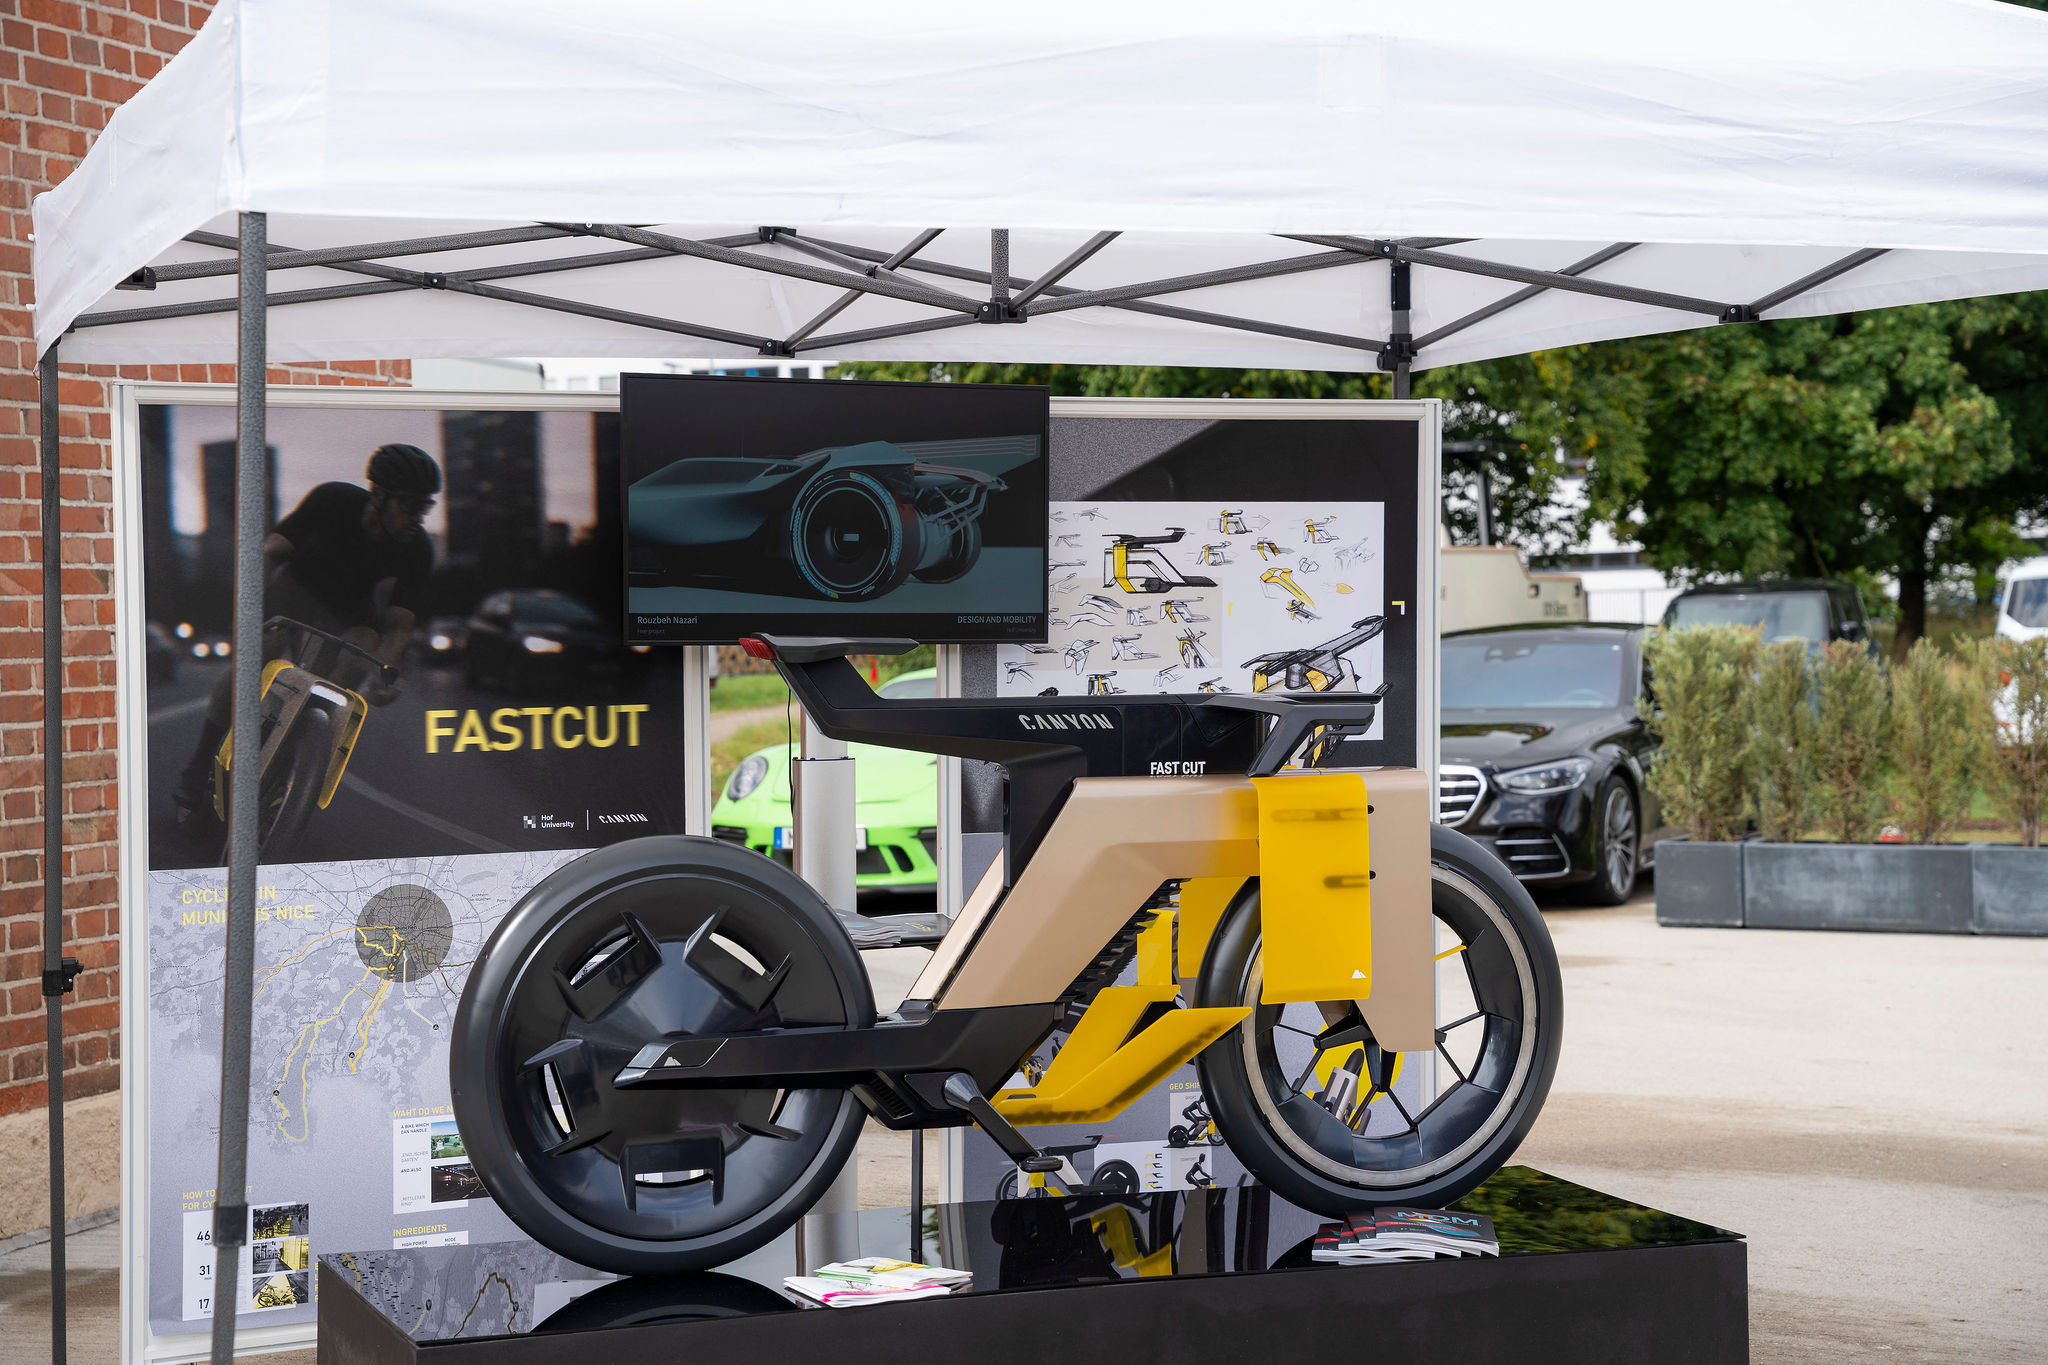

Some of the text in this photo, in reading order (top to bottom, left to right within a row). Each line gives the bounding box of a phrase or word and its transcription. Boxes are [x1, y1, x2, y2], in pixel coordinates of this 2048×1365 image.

[637, 615, 698, 625] Rouzbeh Nazari
[957, 615, 1037, 624] DESIGN AND MOBILITY
[1018, 713, 1115, 730] CANYON
[424, 703, 650, 754] FASTCUT
[1150, 760, 1206, 775] FAST CUT
[598, 812, 649, 824] CANYON
[541, 820, 575, 829] University
[258, 885, 276, 900] IN
[255, 907, 271, 922] IS
[276, 904, 315, 921] NICE
[1169, 1082, 1184, 1090] GEO
[393, 1107, 417, 1118] WAHT
[418, 1106, 430, 1116] DO
[431, 1105, 445, 1114] WE
[182, 1189, 216, 1200] HOW TO
[182, 1201, 200, 1211] FOR
[196, 1229, 211, 1242] 46
[393, 1224, 448, 1237] INGREDIENTS
[199, 1264, 211, 1276] 31
[199, 1298, 210, 1310] 17
